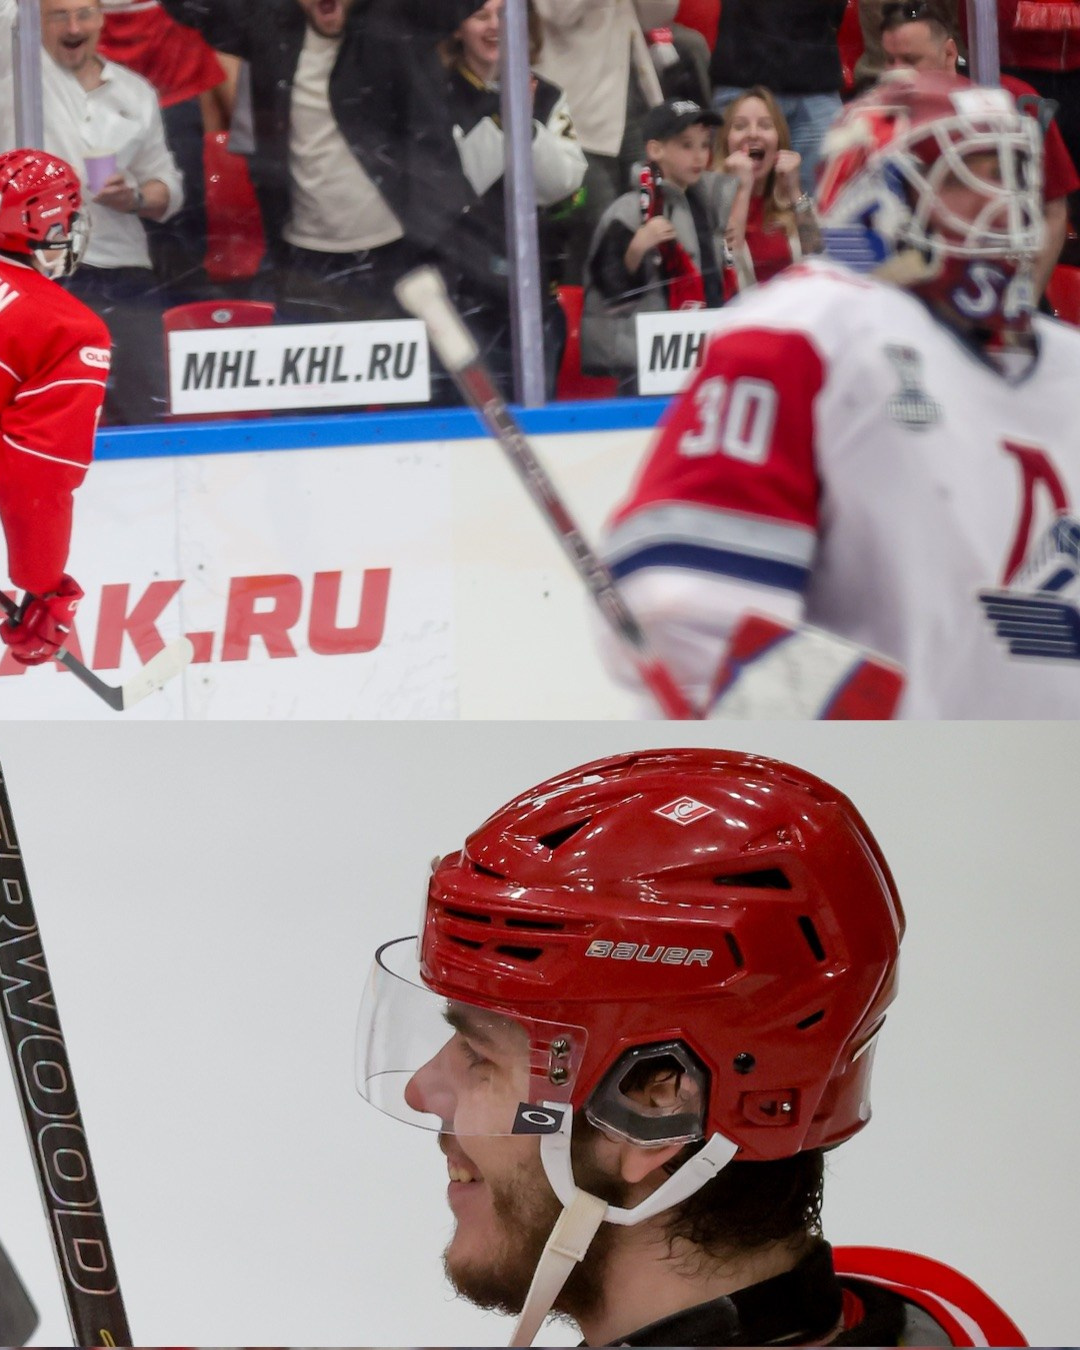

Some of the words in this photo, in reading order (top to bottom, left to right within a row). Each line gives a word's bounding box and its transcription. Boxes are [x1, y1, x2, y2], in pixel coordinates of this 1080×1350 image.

[181, 342, 417, 391] MHL.KHL.RU
[677, 375, 781, 467] 30
[585, 940, 713, 967] BAUER
